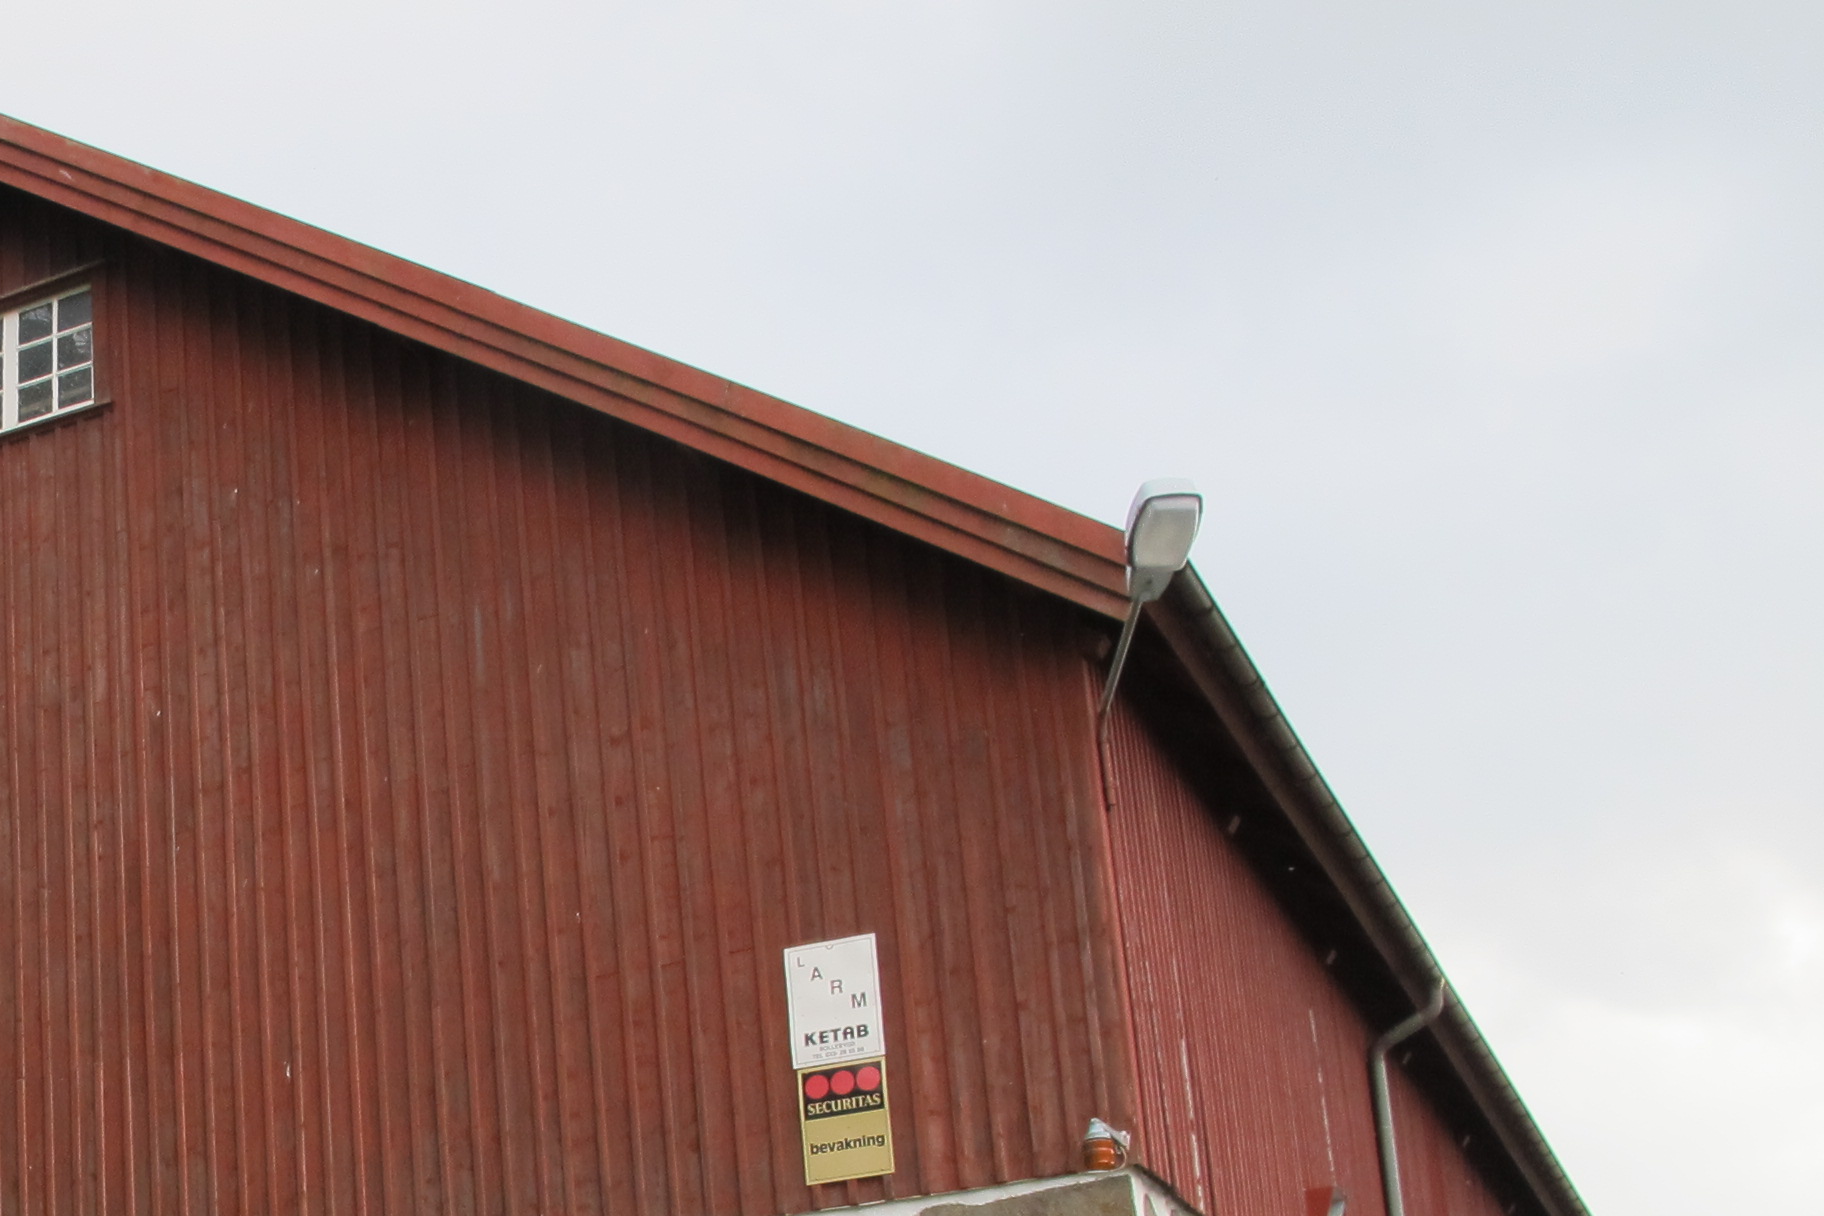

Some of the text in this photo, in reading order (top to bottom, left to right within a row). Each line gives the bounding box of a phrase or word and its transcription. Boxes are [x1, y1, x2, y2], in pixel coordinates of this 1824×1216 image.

[805, 1024, 869, 1046] KETAB
[807, 1093, 881, 1115] SECURITAS
[810, 1133, 885, 1155] bevakning
